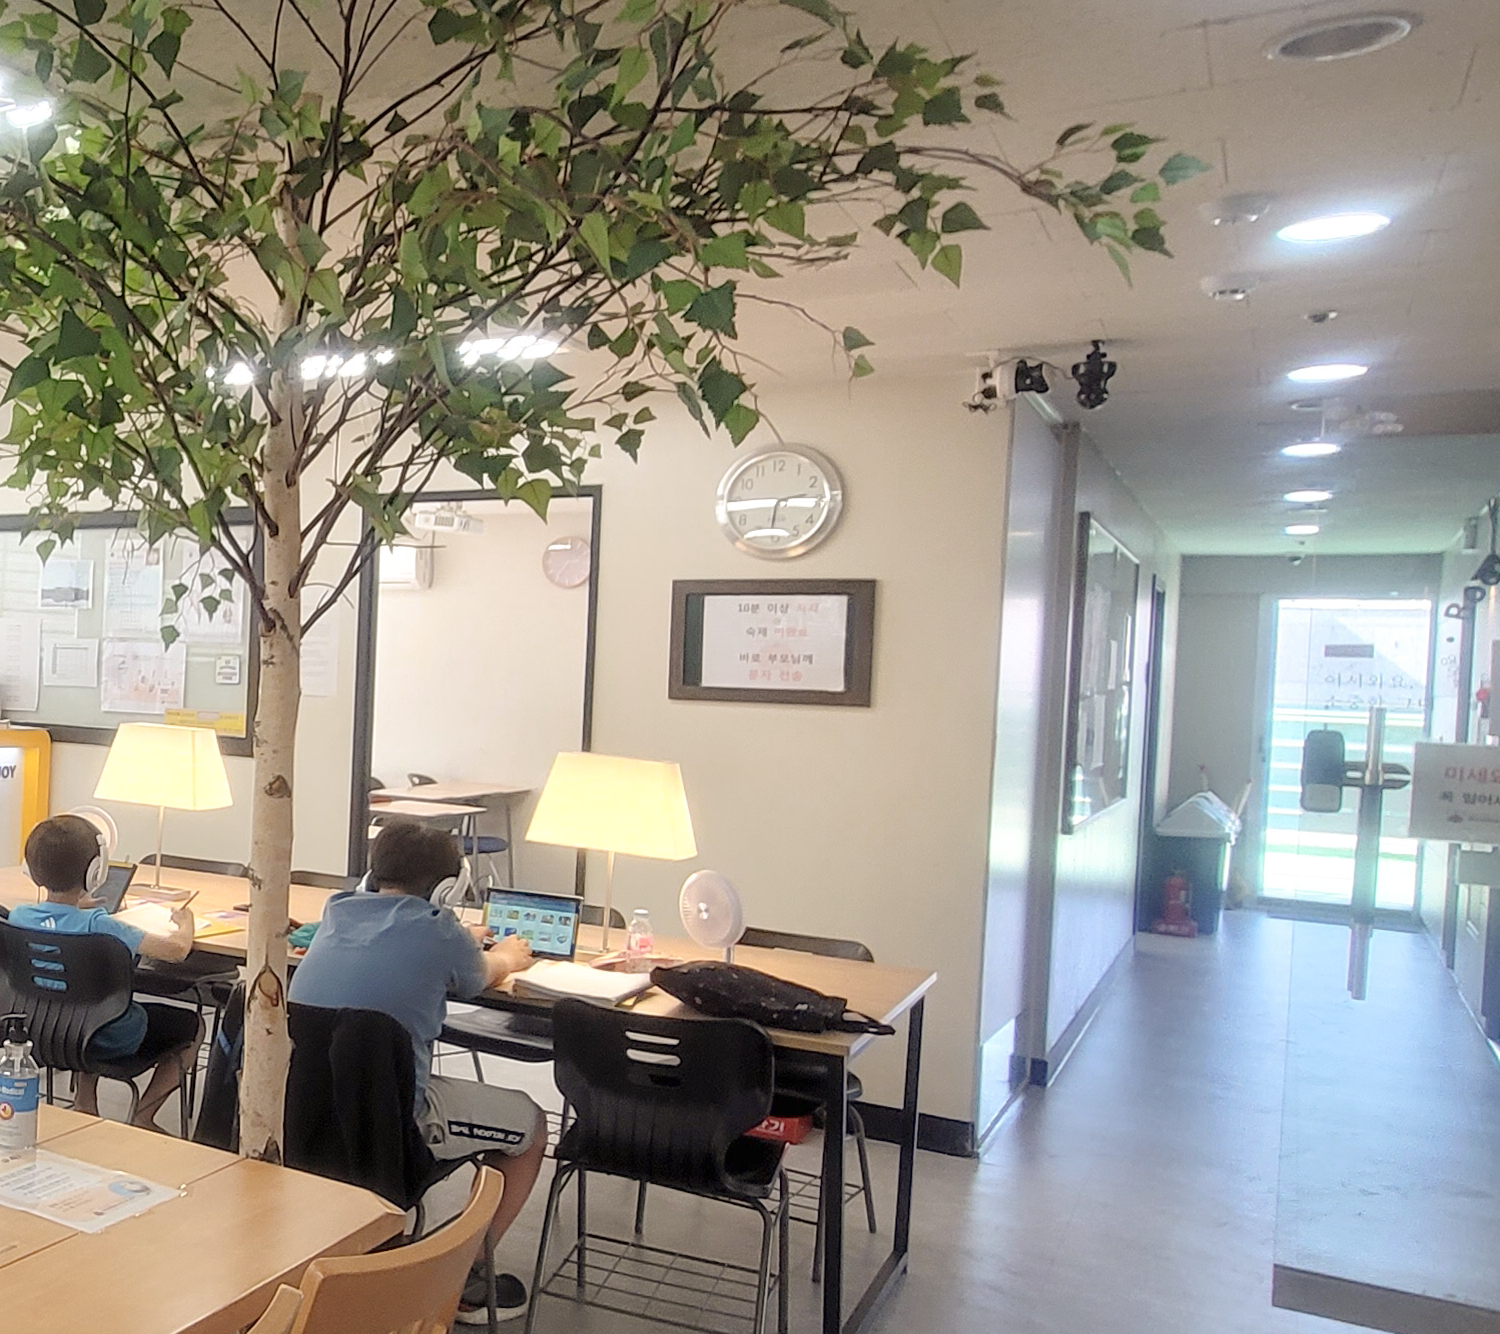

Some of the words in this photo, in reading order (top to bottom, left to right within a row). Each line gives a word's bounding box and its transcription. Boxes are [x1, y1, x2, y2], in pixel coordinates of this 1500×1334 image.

[755, 464, 765, 478] 11
[773, 459, 786, 472] 12
[797, 463, 802, 476] 1
[741, 478, 754, 490] 10
[809, 475, 818, 489] 2
[805, 513, 814, 524] 4
[791, 525, 800, 537] 5
